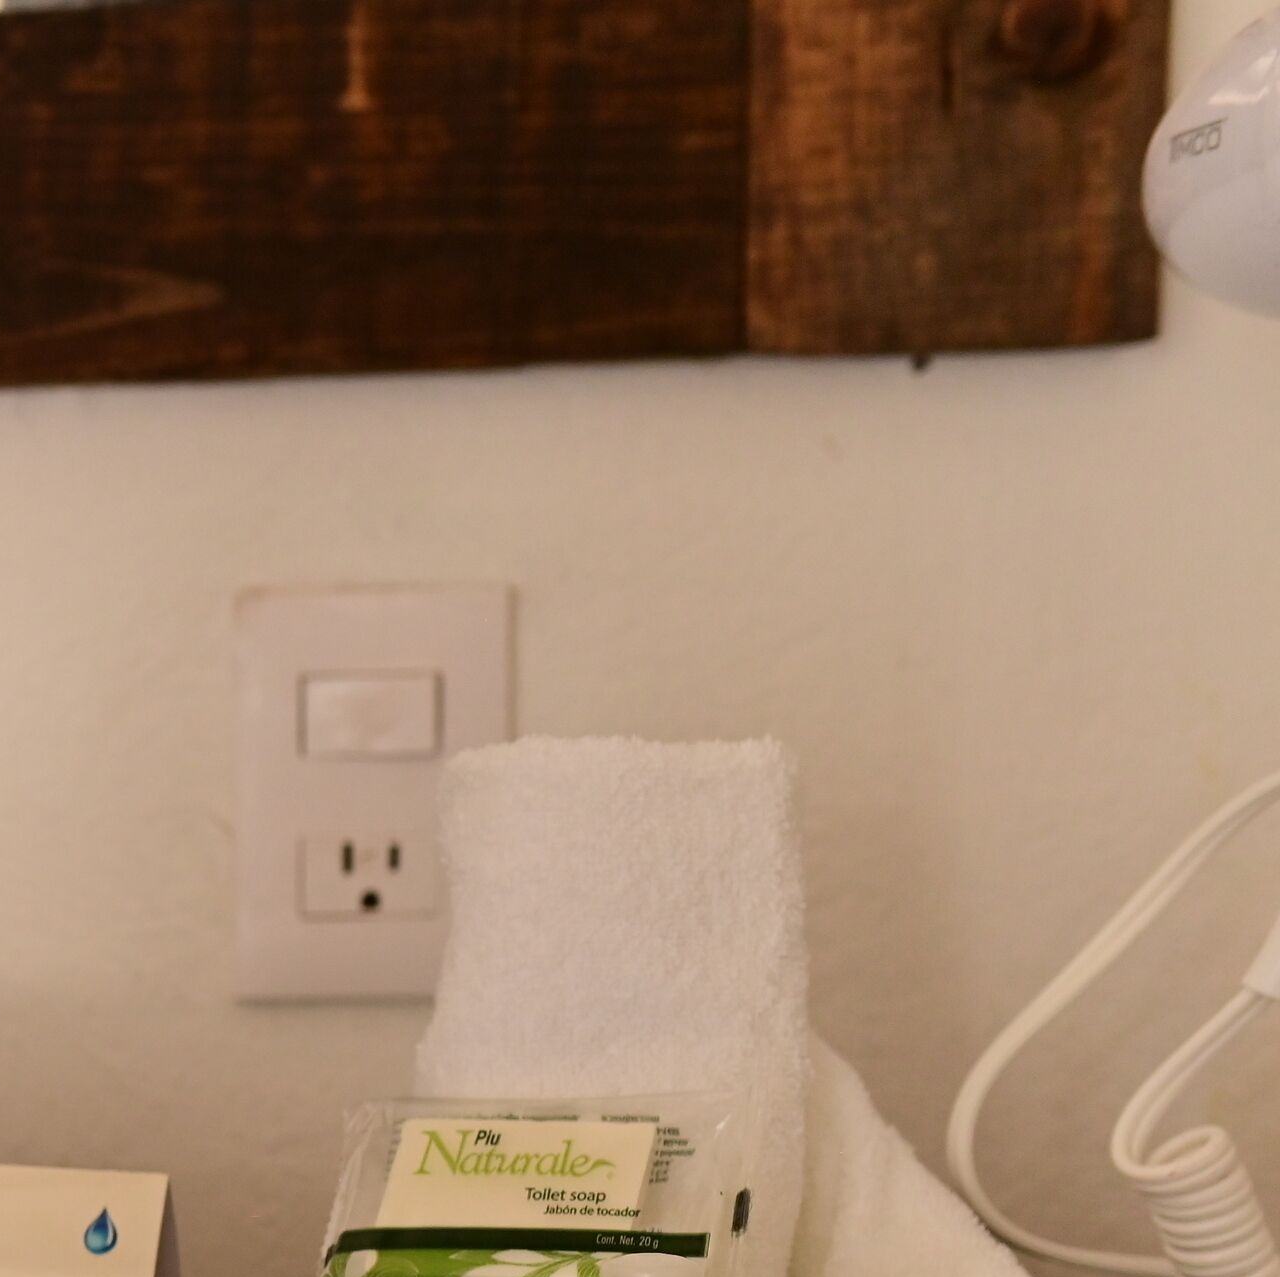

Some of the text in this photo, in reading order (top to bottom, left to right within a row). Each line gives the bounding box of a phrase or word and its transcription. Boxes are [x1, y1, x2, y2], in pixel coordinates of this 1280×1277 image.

[413, 1129, 617, 1178] Naturale
[525, 1187, 607, 1203] Toilet soap
[544, 1205, 640, 1218] Jabón de tocador
[596, 1234, 659, 1250] Cont. Net. 20 g
